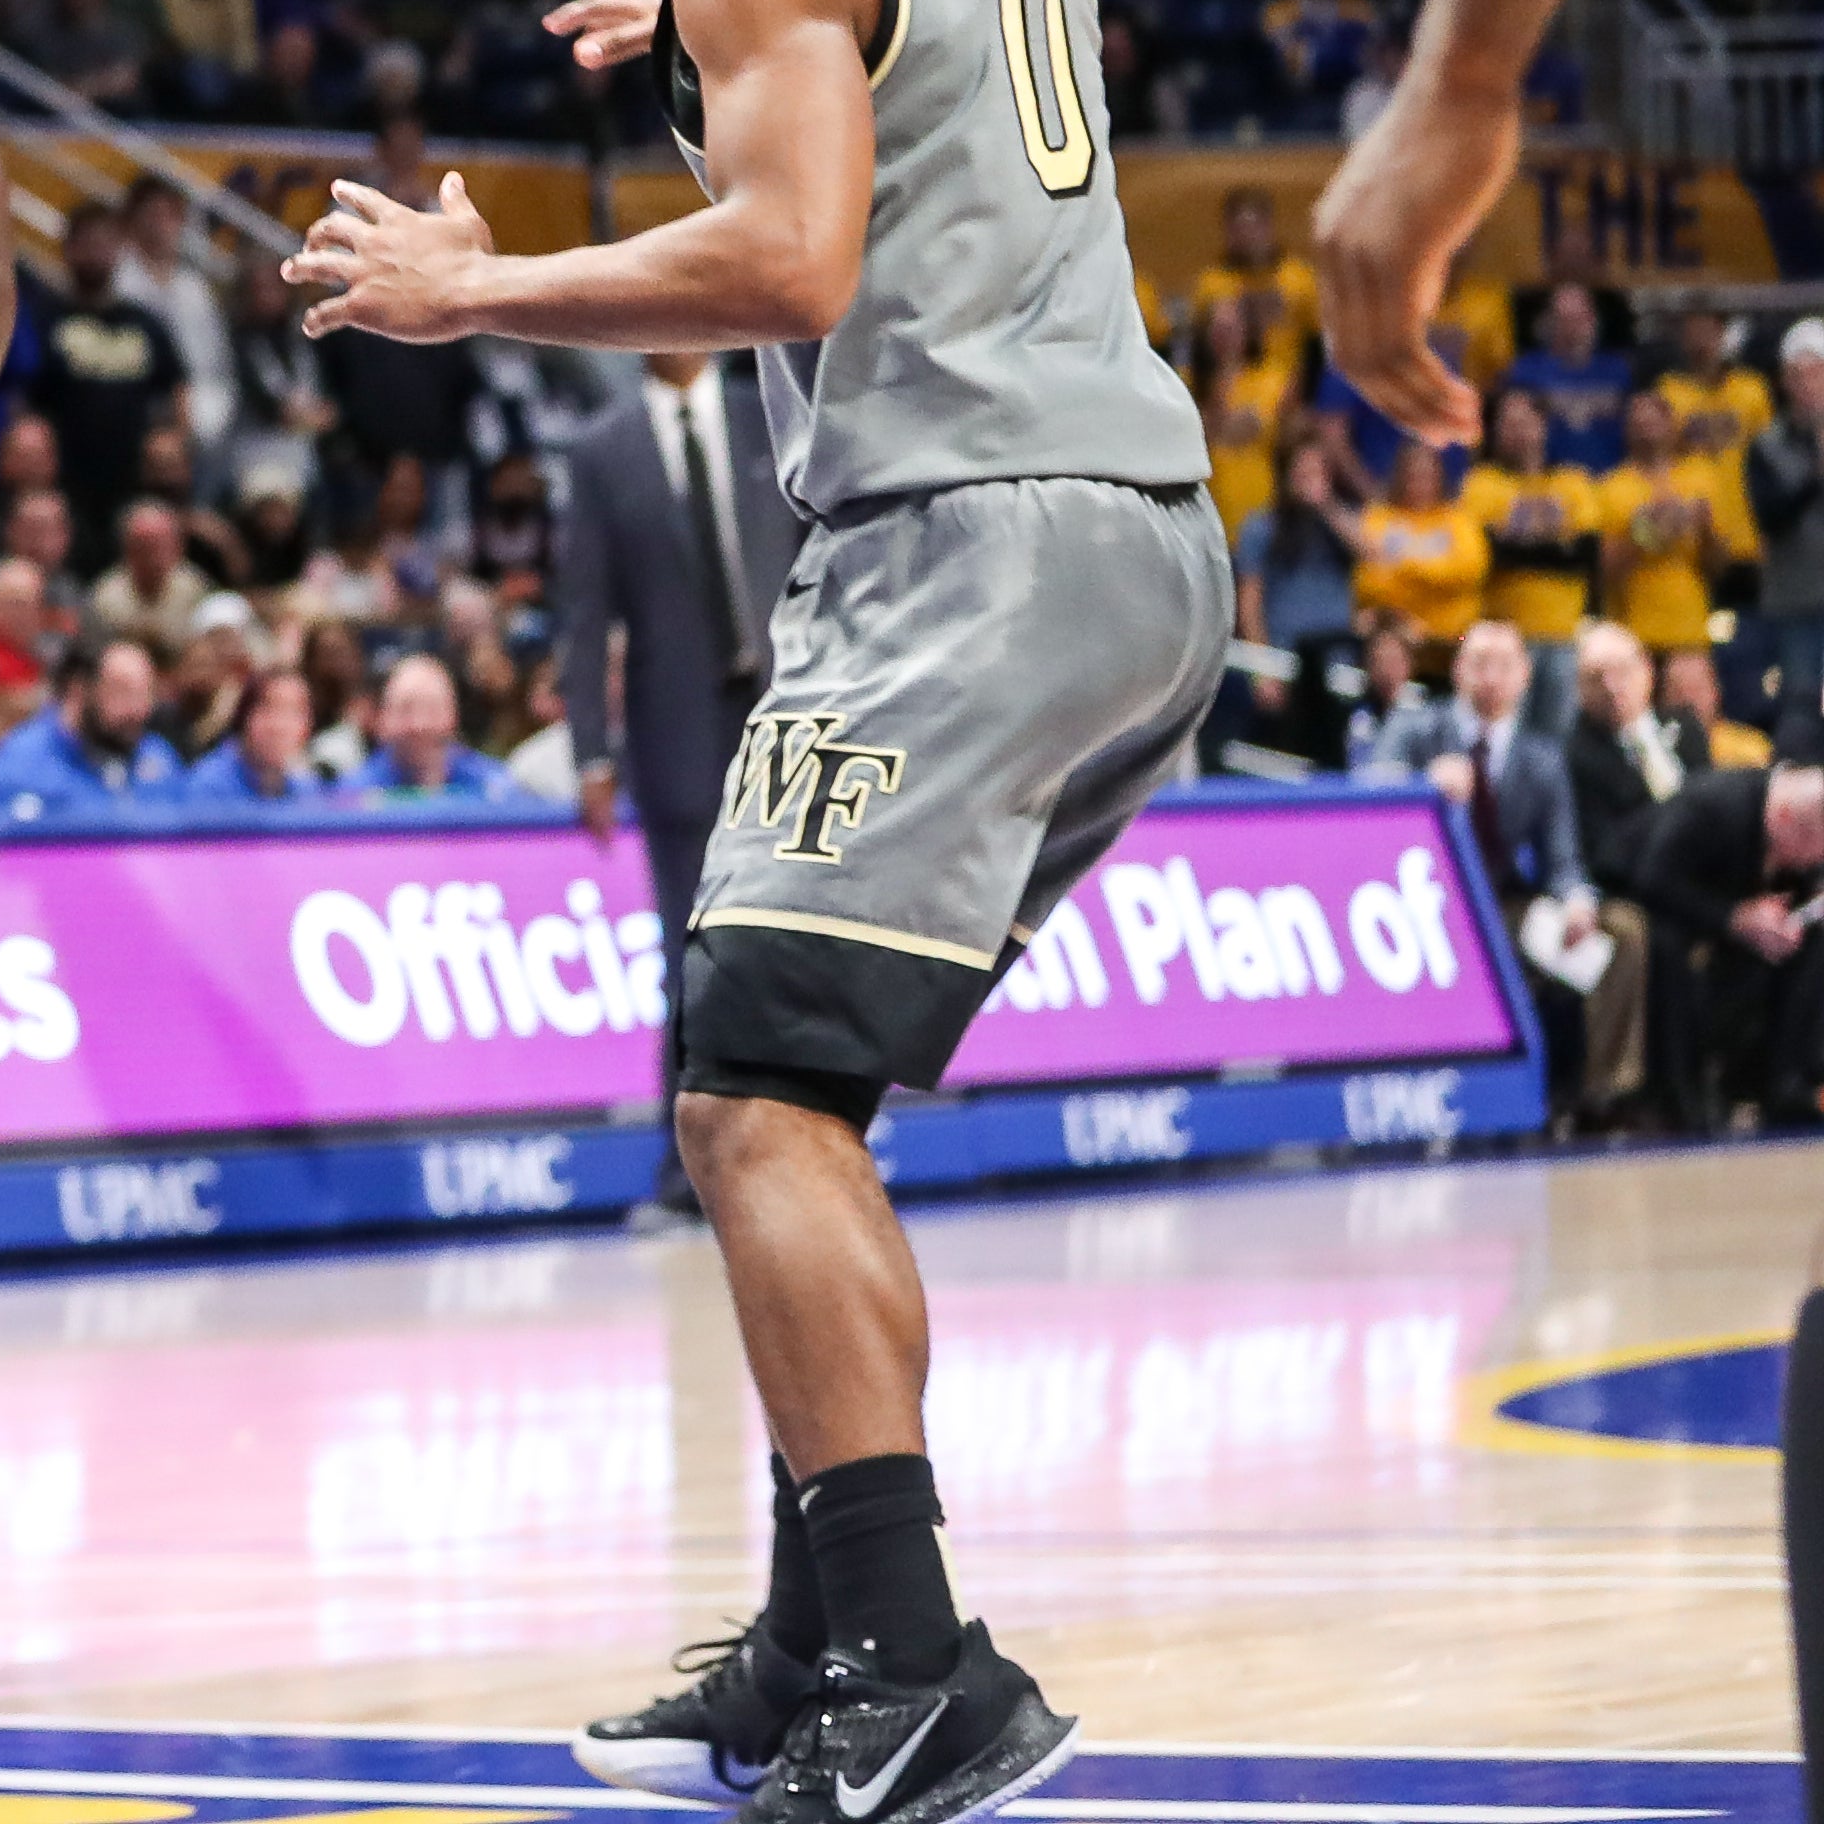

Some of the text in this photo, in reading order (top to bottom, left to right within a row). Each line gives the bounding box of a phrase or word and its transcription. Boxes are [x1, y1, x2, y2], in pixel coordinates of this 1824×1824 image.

[1532, 164, 1704, 270] THE
[723, 709, 908, 866] WF
[288, 880, 667, 1048] Officia
[1101, 856, 1345, 1006] Plan
[1348, 845, 1458, 993] of
[1062, 1087, 1193, 1164] UPMC
[1342, 1069, 1462, 1144] UPMC
[58, 1159, 222, 1242] UPMC
[421, 1138, 574, 1218] UPMC
